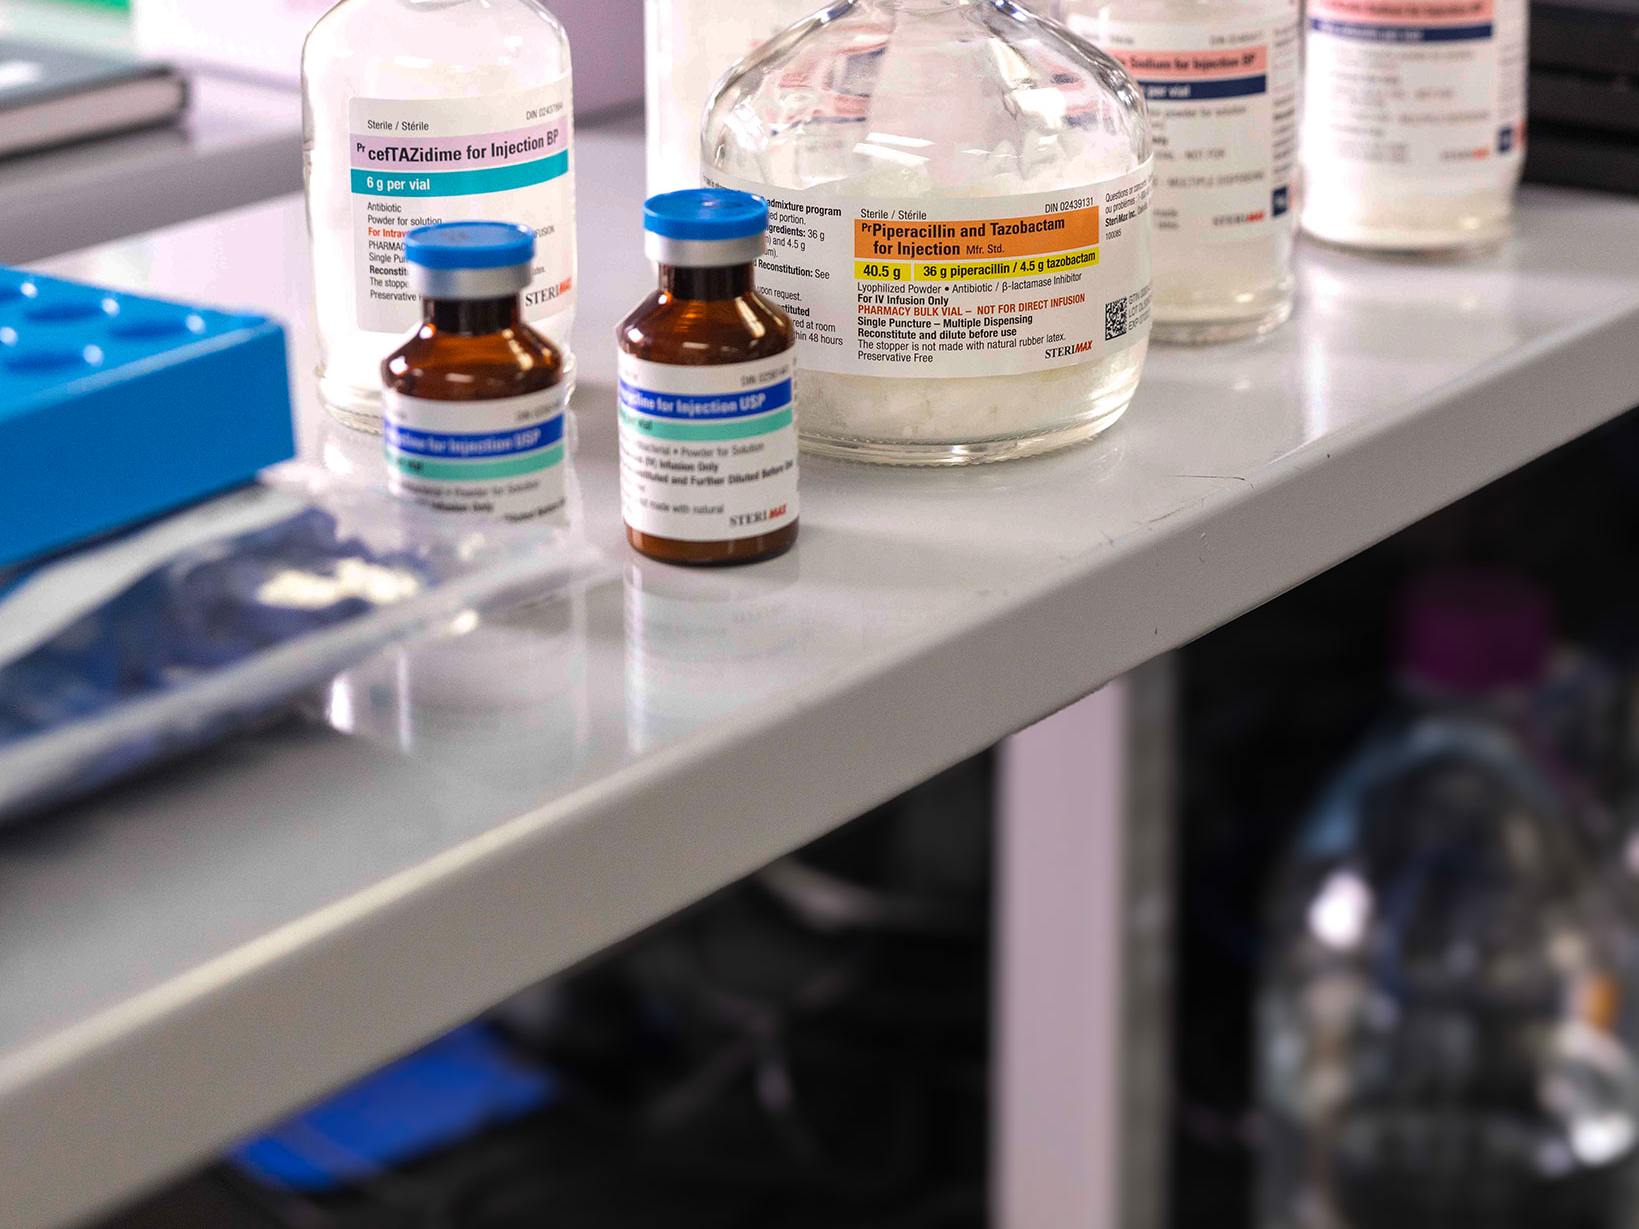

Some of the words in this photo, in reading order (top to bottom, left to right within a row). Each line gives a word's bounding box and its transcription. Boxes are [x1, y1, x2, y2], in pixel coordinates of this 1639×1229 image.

[526, 110, 538, 121] DIN
[367, 119, 393, 131] Sterile
[401, 120, 429, 131] Stérile
[356, 142, 366, 153] Pr
[368, 146, 462, 162] cefTAZidime
[466, 144, 487, 160] for
[491, 136, 544, 159] Injection
[546, 128, 559, 146] BP
[366, 175, 374, 189] 6
[376, 179, 384, 192] g
[387, 179, 406, 194] per
[408, 178, 431, 191] vial
[1105, 188, 1129, 203] Questions
[367, 201, 402, 213] Antibiotic
[766, 198, 804, 212] admixture
[805, 204, 842, 217] program
[1044, 203, 1058, 213] DIN
[1059, 197, 1094, 212] 02439131
[368, 214, 395, 226] Powder
[397, 216, 408, 226] for
[410, 216, 443, 226] solution
[779, 213, 807, 225] portion.
[860, 208, 889, 219] Sterile
[898, 209, 927, 221] Stérile
[368, 226, 381, 237] For
[807, 228, 818, 239] 36
[819, 231, 825, 242] g
[960, 222, 986, 238] and
[989, 218, 1066, 236] Tazobactam
[772, 236, 786, 247] and
[786, 238, 799, 249] 4.5
[800, 242, 806, 252] g
[873, 240, 894, 255] for
[897, 241, 961, 259] Injection
[966, 244, 985, 255] Mfr.
[987, 243, 1005, 254] Std.
[368, 251, 392, 264] Single
[369, 264, 409, 276] Reconstit
[758, 259, 813, 278] Reconstitution:
[814, 268, 830, 280] See
[863, 264, 889, 278] 40.5
[892, 267, 901, 281] g
[923, 265, 937, 277] 36
[940, 267, 947, 279] g
[950, 262, 1010, 279] piperacillin
[1019, 260, 1036, 272] 4.5
[1037, 260, 1044, 273] g
[1046, 251, 1096, 269] tazobactam
[369, 276, 383, 287] The
[857, 282, 905, 294] Lyophilized
[908, 284, 942, 294] Powder
[952, 283, 993, 294] Antibiotic
[1001, 277, 1052, 293] β-lactamase
[1053, 272, 1082, 285] Inhibitor
[370, 289, 417, 302] Preservative
[773, 288, 802, 302] request.
[857, 293, 873, 304] For
[875, 294, 885, 304] IV
[887, 295, 926, 306] Infusion
[928, 295, 950, 307] Only
[857, 304, 911, 316] PHARMACY
[913, 306, 939, 317] BULK
[941, 306, 963, 317] VIAL
[977, 304, 996, 315] NOT
[998, 303, 1016, 314] FOR
[1018, 299, 1049, 312] DIRECT
[1050, 293, 1086, 308] INFUSION
[805, 320, 814, 330] at
[815, 322, 836, 333] room
[857, 316, 887, 329] Single
[889, 317, 932, 329] Puncture
[943, 317, 981, 330] Multiple
[983, 314, 1033, 328] Dispensing
[808, 332, 819, 343] 48
[820, 333, 844, 346] hours
[857, 327, 917, 340] Reconstitute
[919, 330, 937, 340] and
[939, 329, 967, 340] dilute
[968, 328, 998, 339] before
[1000, 327, 1018, 338] use
[857, 338, 874, 350] The
[876, 340, 909, 352] stopper
[911, 340, 920, 351] is
[921, 341, 937, 351] not
[938, 340, 964, 352] made
[965, 340, 985, 351] with
[986, 337, 1017, 350] natural
[1019, 335, 1044, 347] rubber
[1046, 332, 1067, 344] latex.
[857, 350, 912, 363] Preservative
[913, 352, 934, 363] Free
[1044, 340, 1093, 360] STERIMAX
[656, 396, 674, 413] for
[675, 398, 738, 417] Injection
[739, 392, 767, 410] USP
